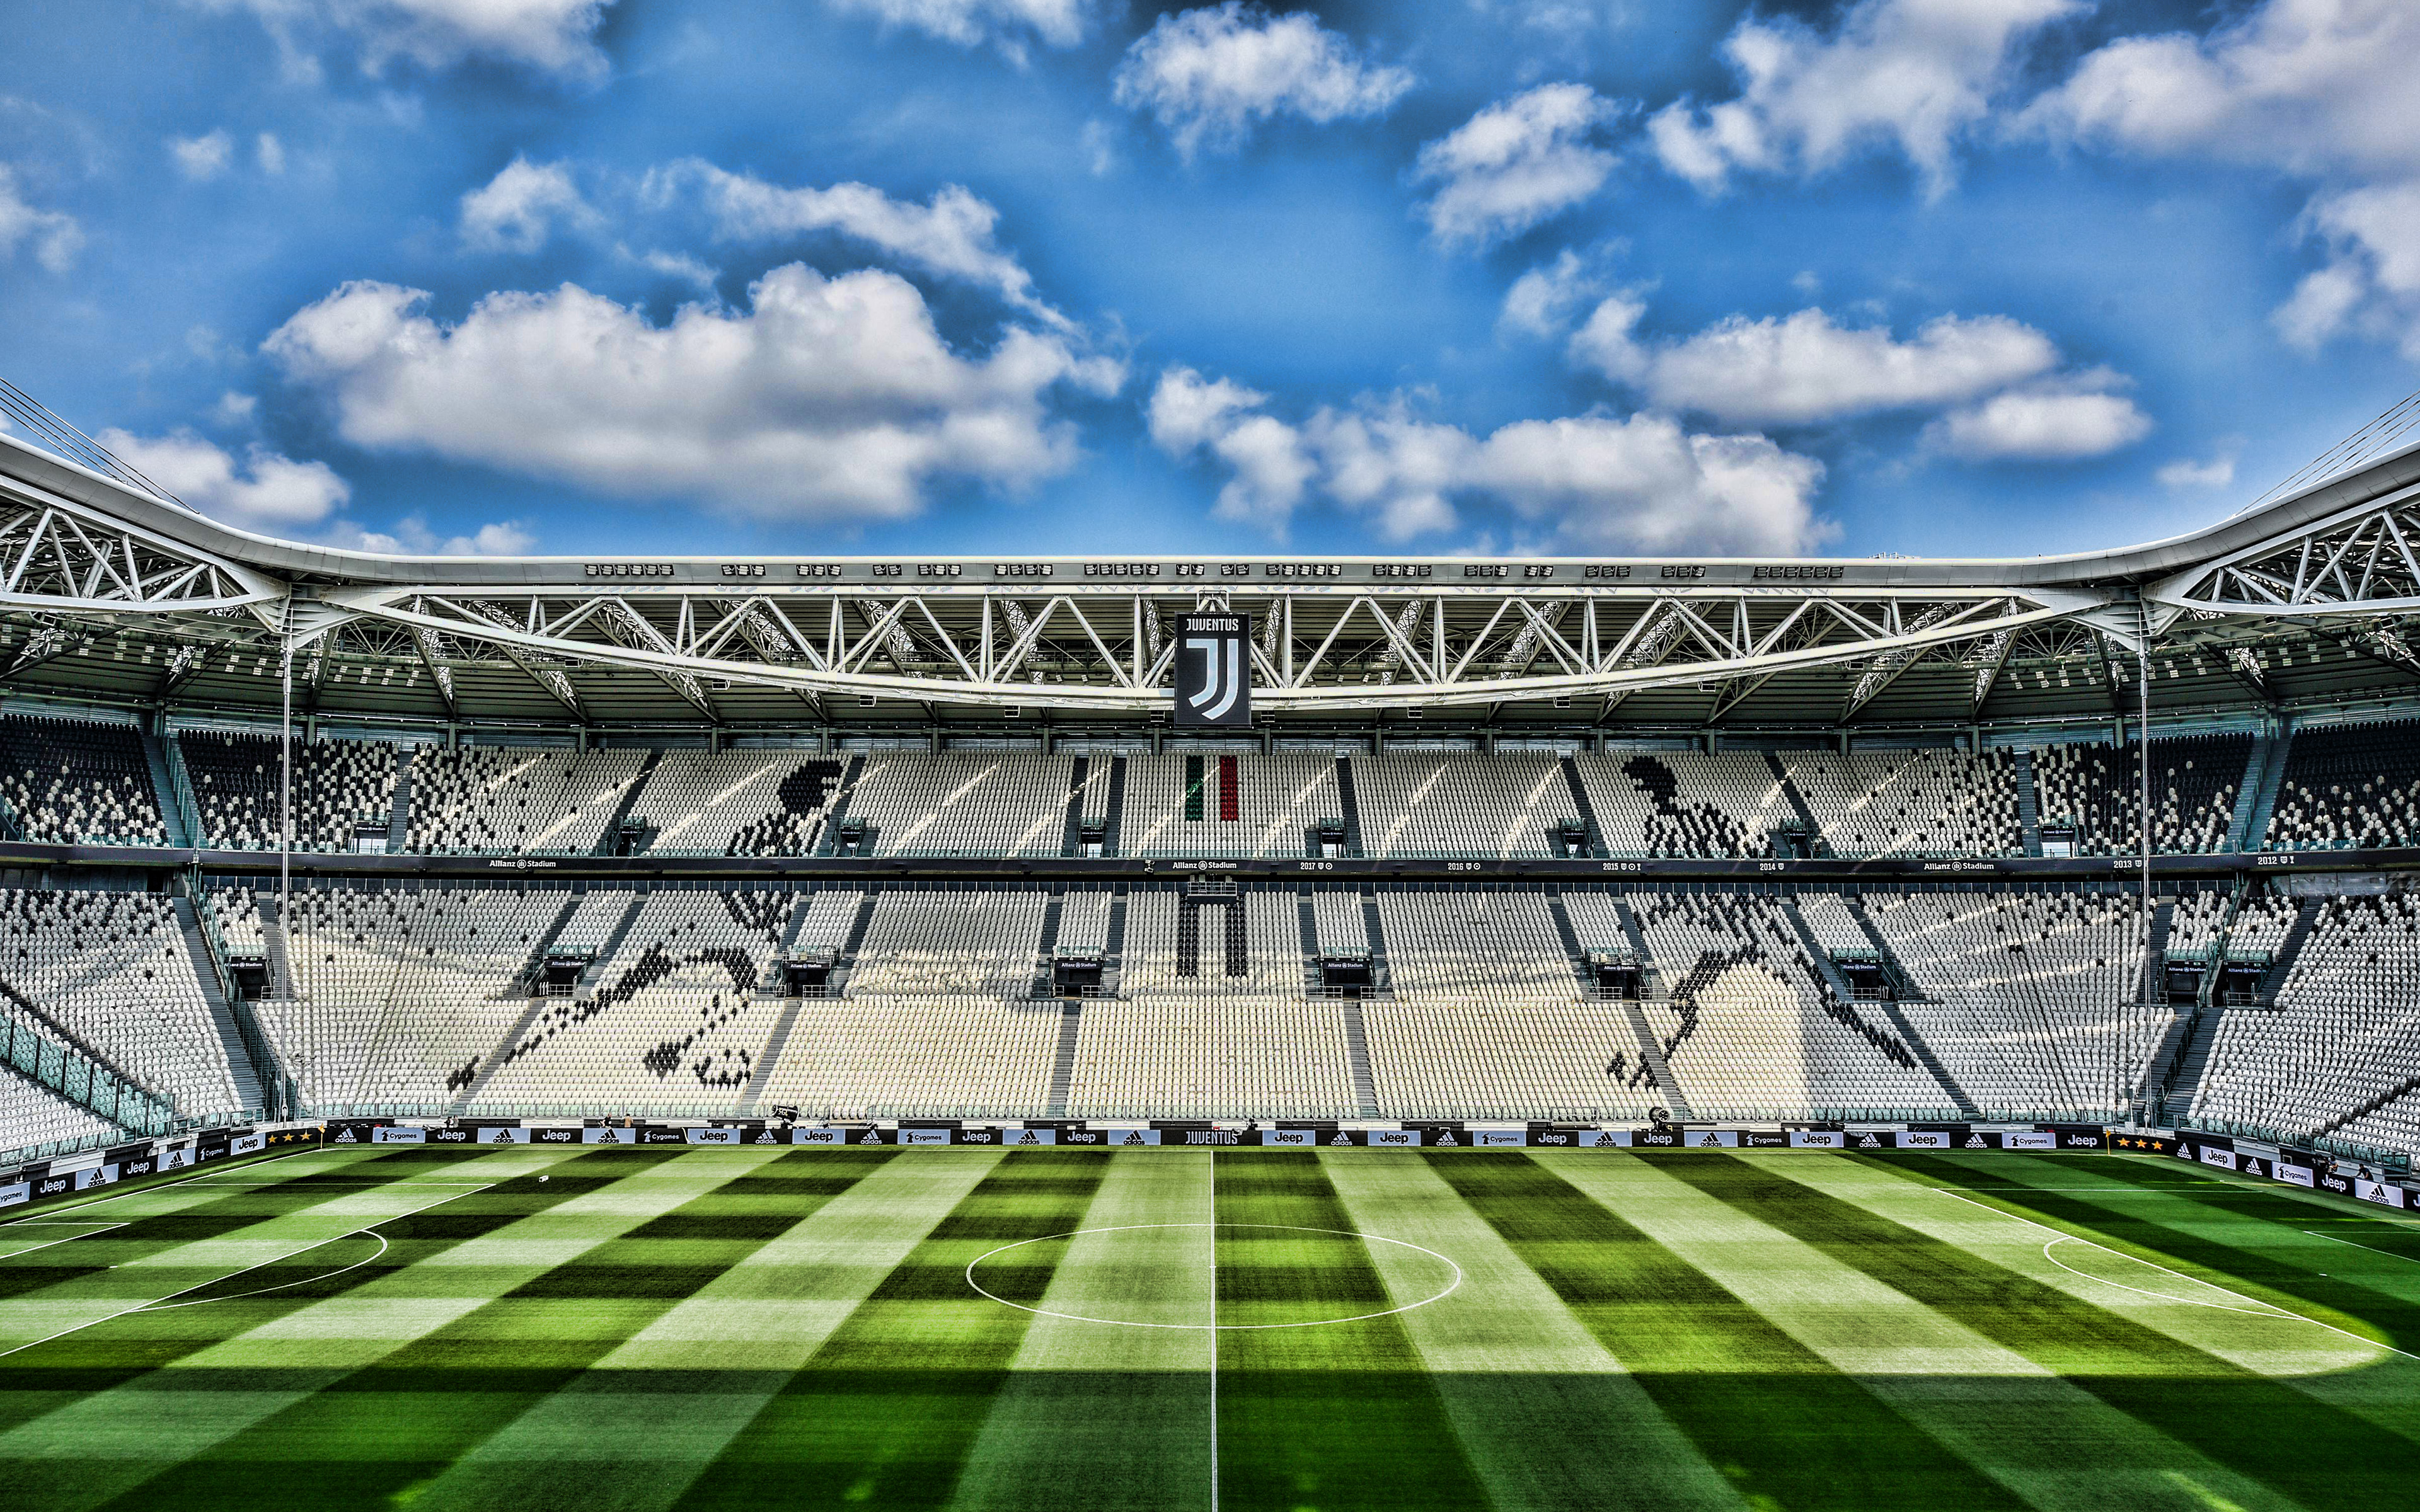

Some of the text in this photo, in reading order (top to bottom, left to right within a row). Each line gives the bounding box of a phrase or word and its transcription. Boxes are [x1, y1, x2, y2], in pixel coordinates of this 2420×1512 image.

[1186, 618, 1239, 631] JUVENTUS
[1448, 862, 1463, 871] 2016
[2113, 861, 2132, 869] 2013
[2257, 857, 2278, 865] 2012
[437, 1130, 466, 1142] Jeep
[542, 1130, 571, 1142] Jeep
[700, 1130, 728, 1142] Jeep
[804, 1130, 833, 1142] Jeep
[962, 1131, 991, 1143] Jeep
[1068, 1131, 1096, 1143] Jeep
[1185, 1131, 1238, 1144] JUVENTUS
[1274, 1132, 1303, 1144] Jeep
[1380, 1132, 1409, 1144] Jeep
[1538, 1133, 1567, 1145] Jeep
[1644, 1133, 1673, 1145] Jeep
[1802, 1133, 1831, 1145] Jeep
[1908, 1133, 1937, 1145] Jeep
[2068, 1135, 2097, 1147] Jeep
[239, 1138, 258, 1150] Jeep
[205, 1147, 224, 1157] Cygames
[2177, 1152, 2192, 1160] adidas
[2208, 1149, 2228, 1165] Jeep
[127, 1161, 149, 1174] Jeep
[168, 1160, 184, 1170] adidas
[2245, 1166, 2262, 1176] adidas
[2285, 1170, 2307, 1181] Cygames
[40, 1179, 66, 1194] Jeep
[88, 1177, 107, 1188] adidas
[2322, 1174, 2346, 1192] Jeep
[2368, 1193, 2390, 1205] adidas
